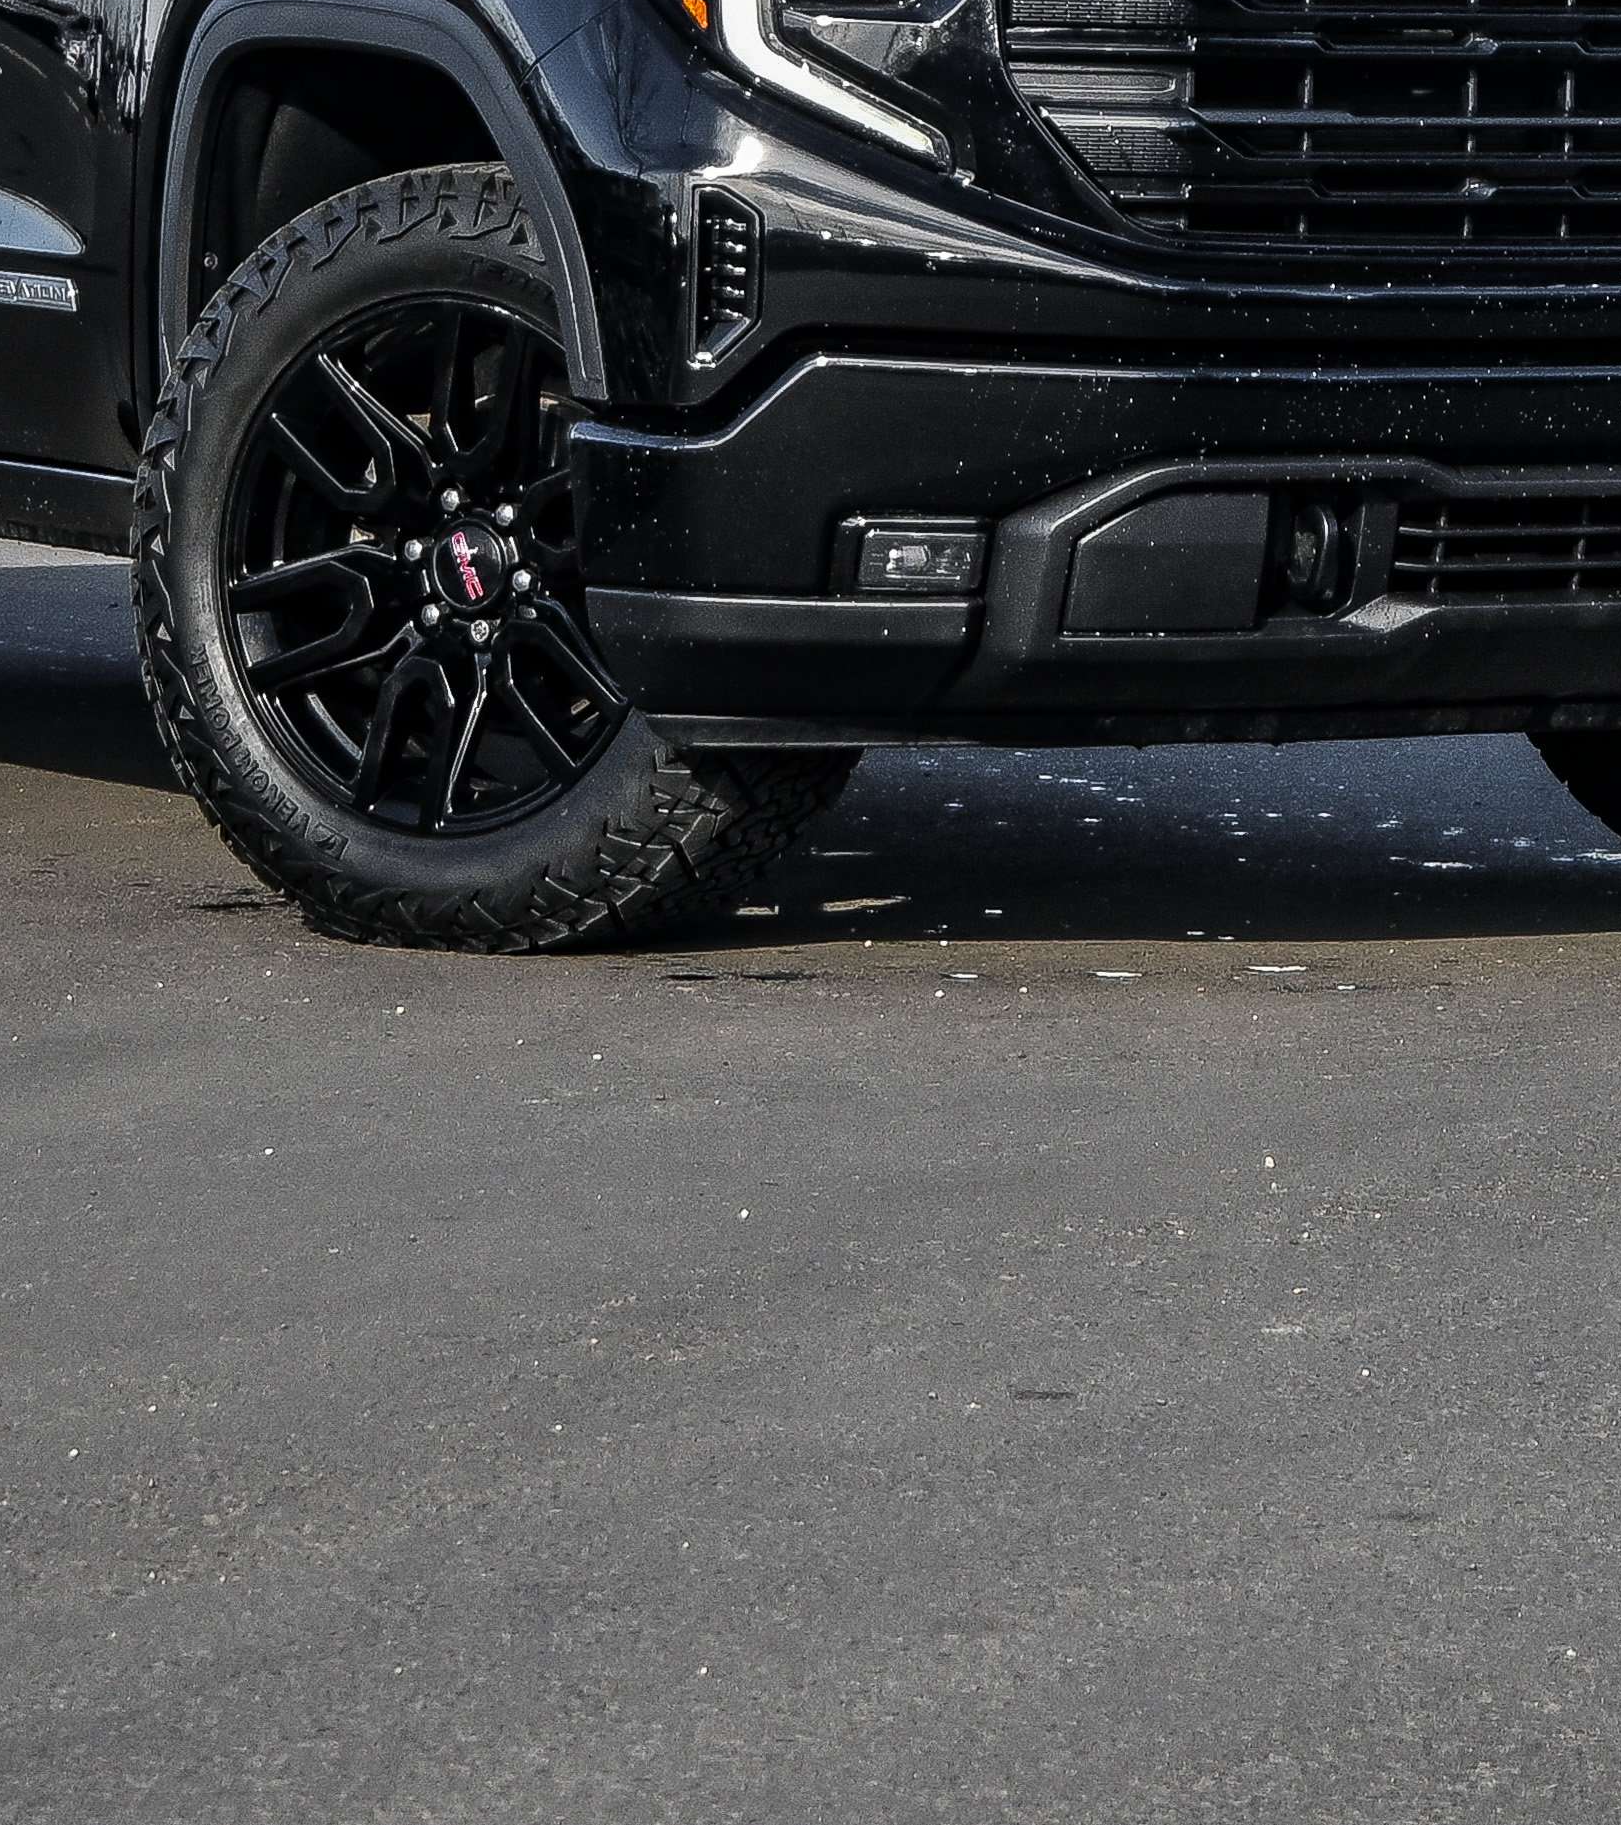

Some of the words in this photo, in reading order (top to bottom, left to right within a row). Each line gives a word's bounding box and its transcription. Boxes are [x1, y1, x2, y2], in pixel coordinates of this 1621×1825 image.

[451, 531, 483, 600] GMC
[189, 642, 243, 753] POWER
[234, 749, 312, 837] VENOM
